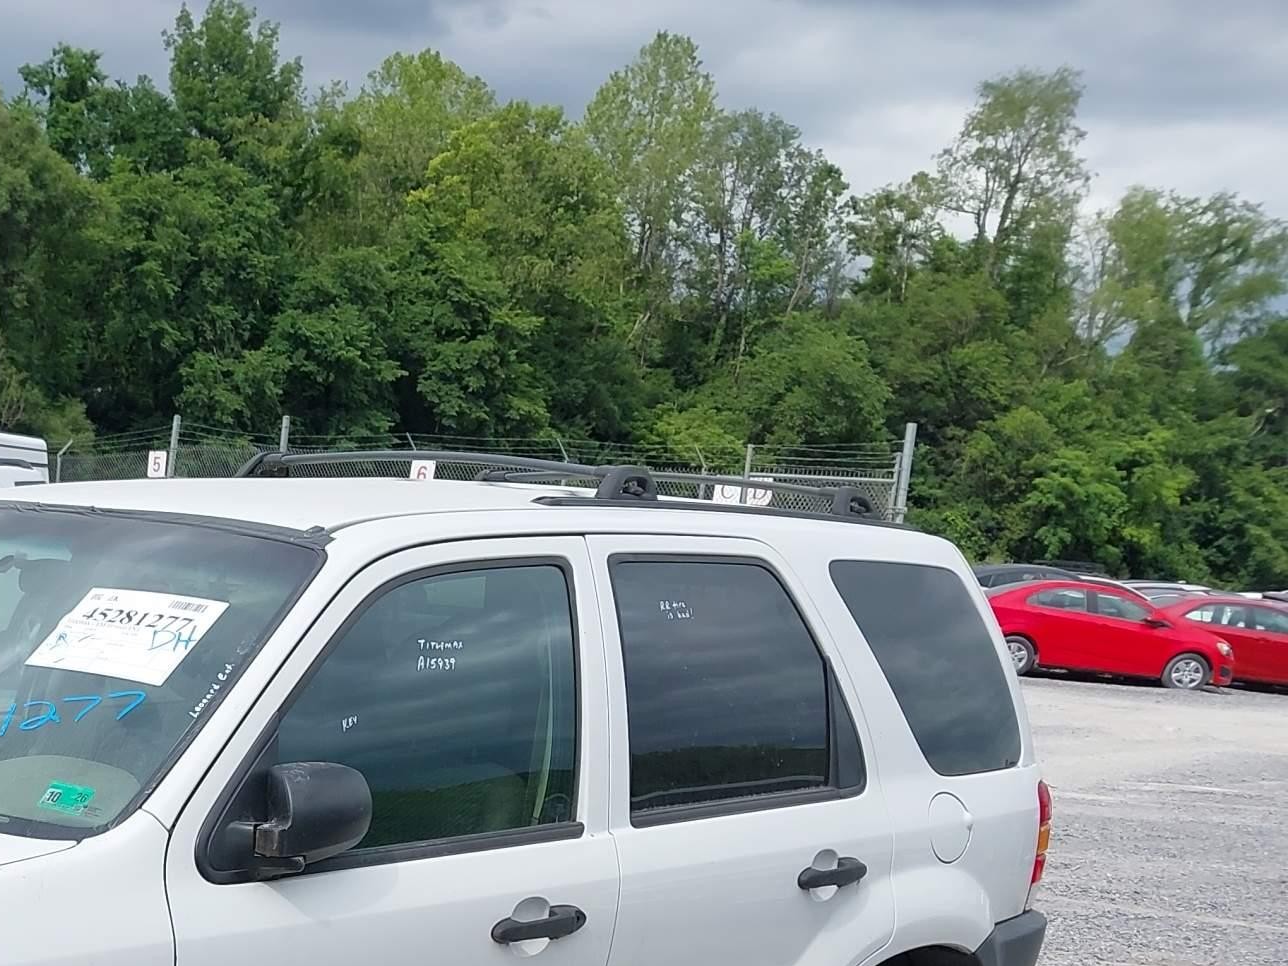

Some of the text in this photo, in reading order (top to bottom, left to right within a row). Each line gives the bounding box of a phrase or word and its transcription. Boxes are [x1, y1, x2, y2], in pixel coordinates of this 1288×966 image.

[152, 456, 161, 473] 5
[417, 465, 428, 480] 6
[82, 607, 196, 632] 45281277
[148, 624, 197, 652] DH
[417, 655, 456, 672] A15939
[46, 790, 63, 803] 10
